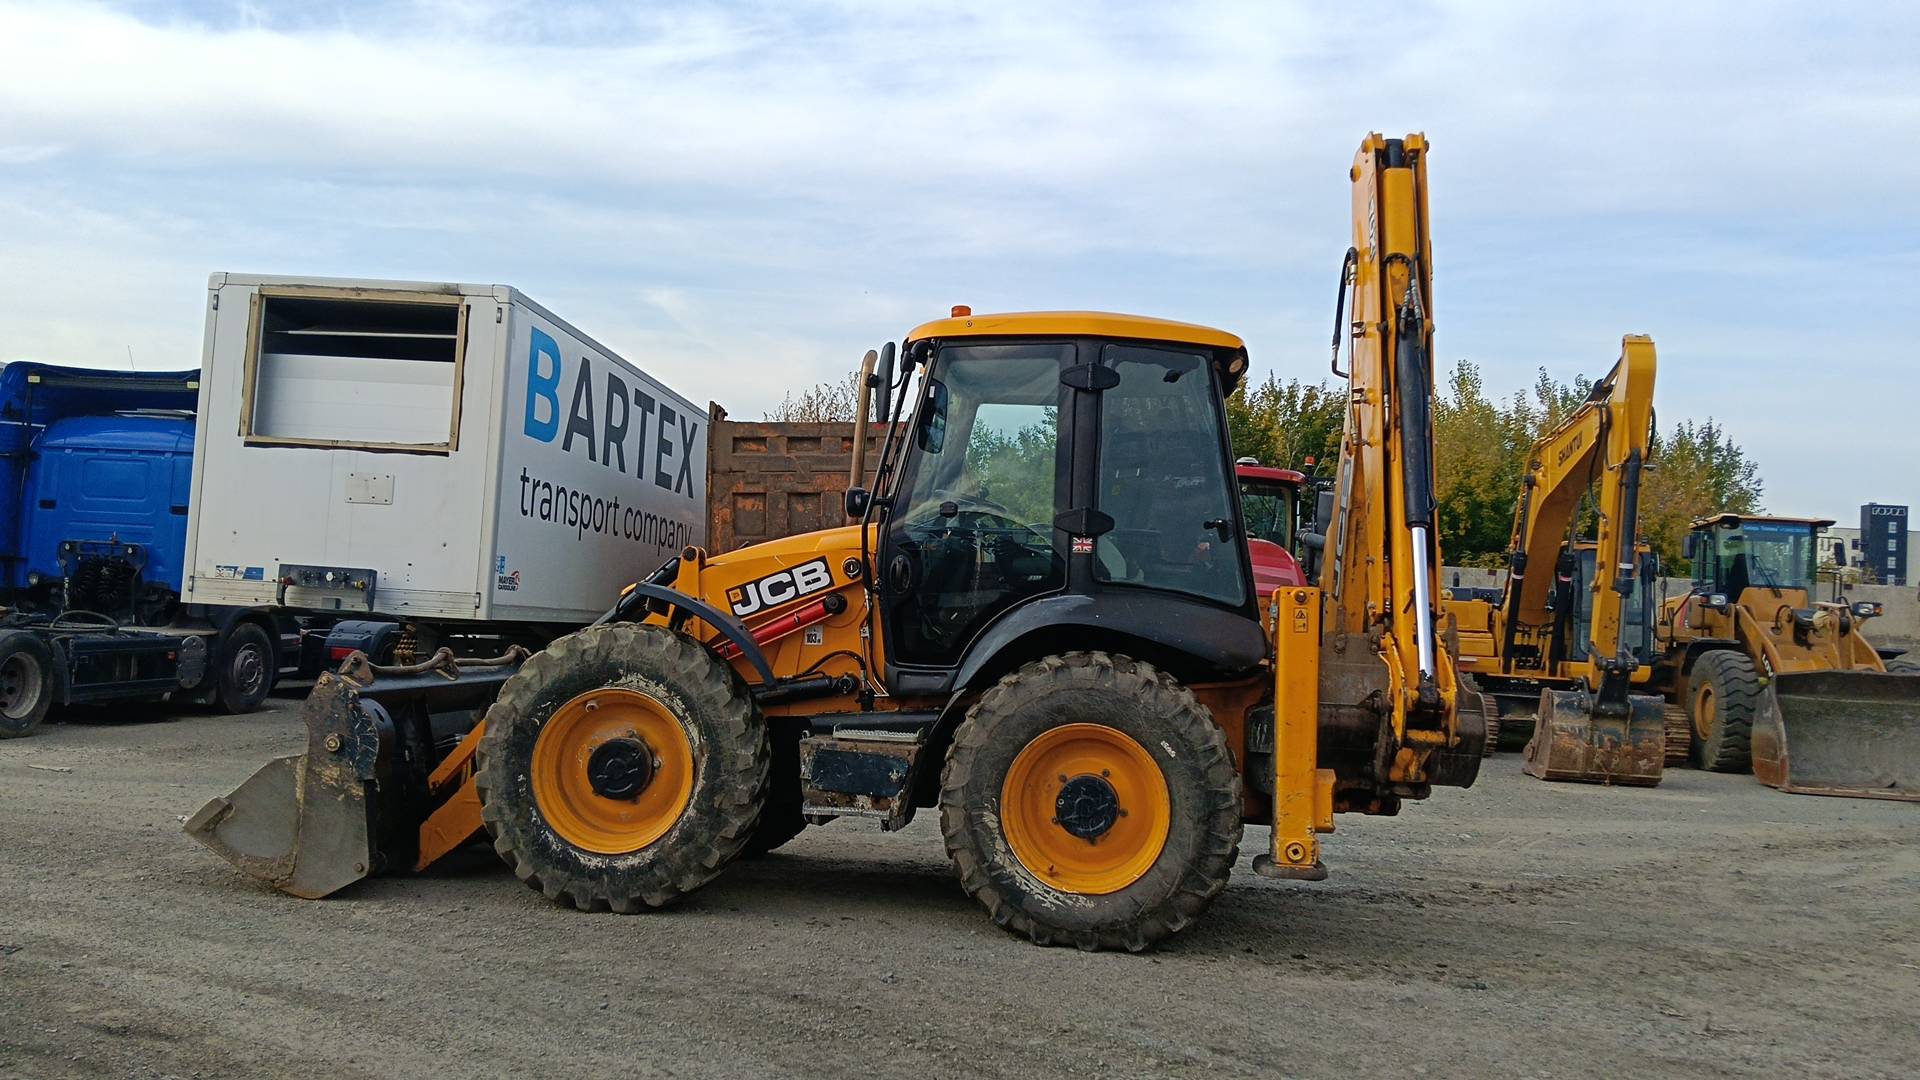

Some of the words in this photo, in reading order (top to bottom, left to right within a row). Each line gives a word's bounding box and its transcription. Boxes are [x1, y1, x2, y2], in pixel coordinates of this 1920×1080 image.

[524, 326, 697, 499] BARTEX
[520, 467, 620, 540] transport
[624, 506, 692, 556] company
[732, 560, 831, 616] JCB
